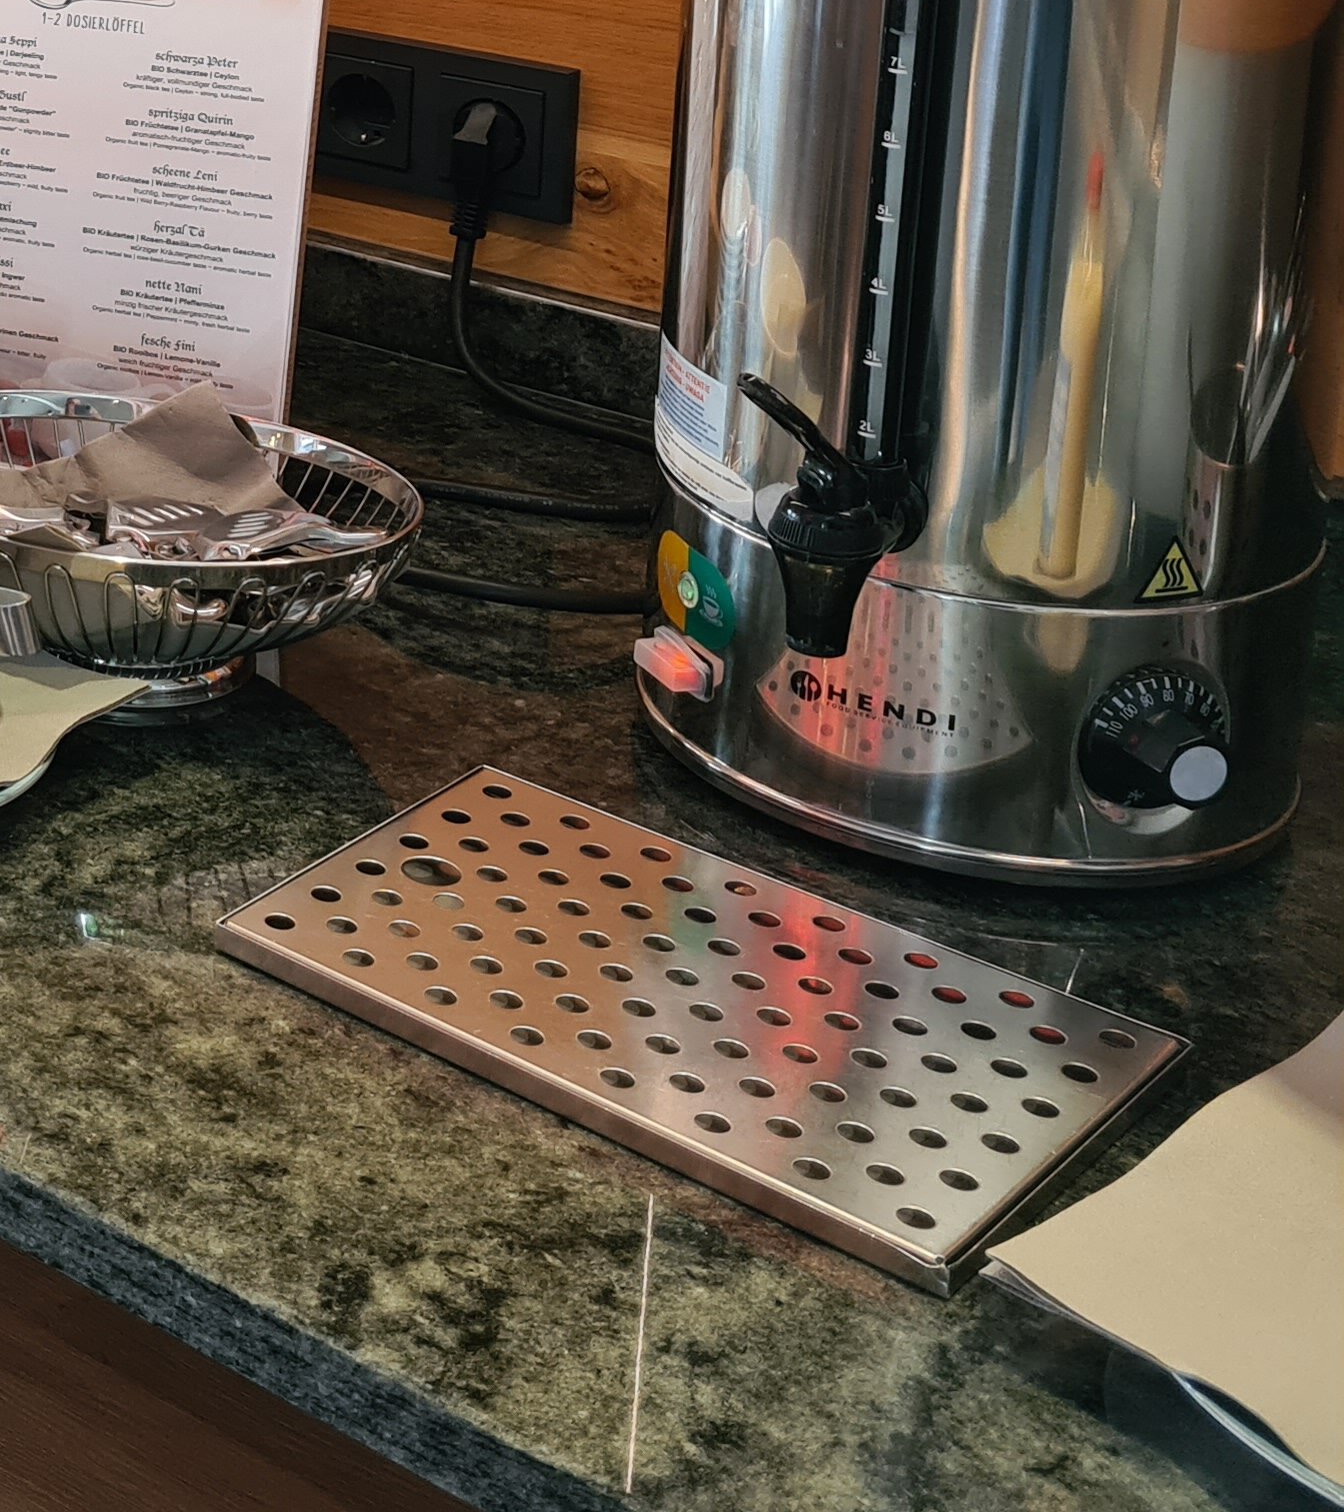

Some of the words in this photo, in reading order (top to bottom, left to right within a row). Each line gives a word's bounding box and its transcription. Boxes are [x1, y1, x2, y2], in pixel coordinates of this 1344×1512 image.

[42, 11, 62, 26] 1-2
[66, 14, 146, 35] DOSIERLÖFFEL
[151, 64, 165, 72] BIO
[890, 56, 906, 69] 7L
[125, 119, 140, 127] BIO
[883, 130, 899, 144] 6L
[96, 172, 111, 180] BIO
[877, 203, 892, 217] 5L
[82, 226, 97, 235] BIO
[870, 277, 887, 289] 4L
[120, 289, 135, 297] BIO
[113, 345, 128, 353] BIO
[865, 348, 881, 362] 3L
[859, 420, 875, 433] 2L
[1139, 693, 1154, 708] 90
[1163, 689, 1175, 702] 80
[1184, 691, 1195, 705] 70
[826, 701, 850, 713] FOOD
[827, 683, 956, 731] HENDI
[1119, 703, 1138, 721] 100
[1106, 720, 1124, 738] 110
